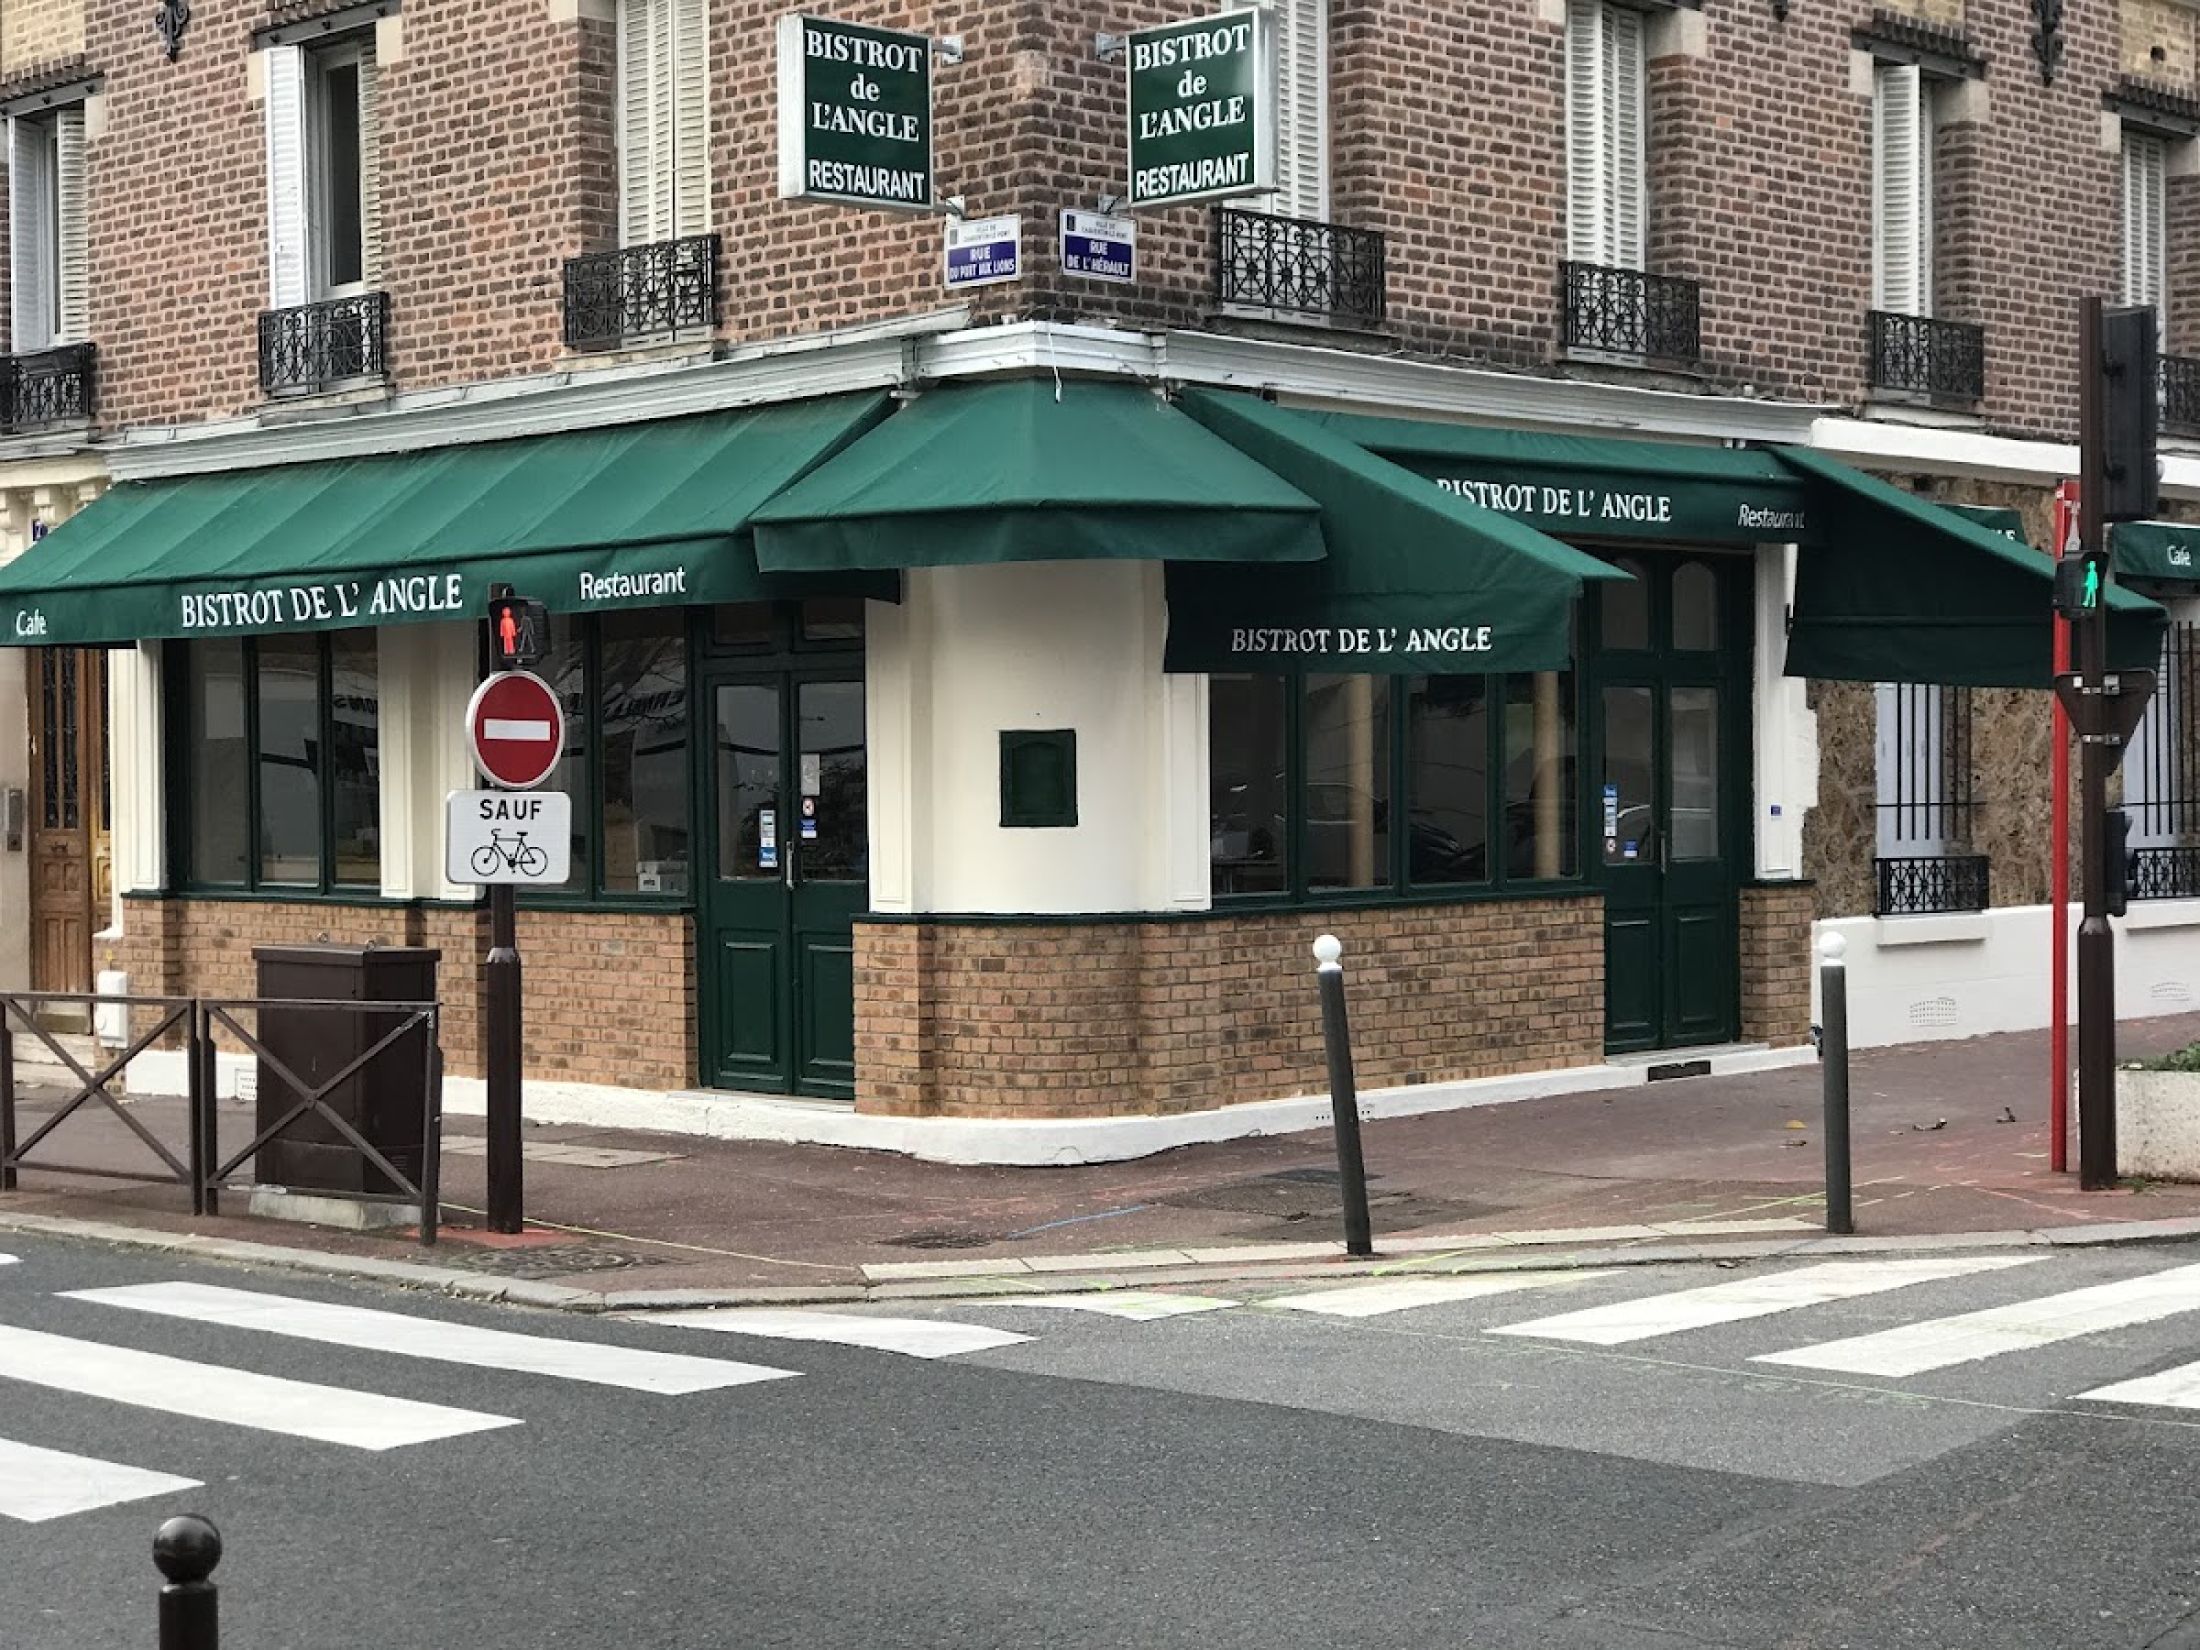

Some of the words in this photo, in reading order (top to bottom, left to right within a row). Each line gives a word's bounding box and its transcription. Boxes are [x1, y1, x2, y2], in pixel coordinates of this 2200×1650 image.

[805, 29, 922, 73] BISTROT
[1134, 23, 1250, 71] BISTROT
[850, 73, 880, 101] de
[1176, 69, 1207, 98] de
[811, 102, 919, 142] L'ANGLE
[1139, 95, 1246, 139] L'ANGLE
[809, 158, 925, 200] RESTAURANT
[1136, 152, 1249, 198] RESTAURANT
[970, 245, 991, 262] RUE
[1067, 254, 1080, 269] DE
[1089, 240, 1108, 256] RUE
[1543, 487, 1572, 516] DE
[1578, 489, 1595, 517] L'
[1601, 493, 1672, 522] ANGLE
[579, 566, 687, 600] Restaurant
[181, 589, 284, 628] BISTROT
[290, 586, 332, 621] DE
[335, 582, 359, 618] L'
[369, 573, 463, 615] ANGLE
[1231, 628, 1332, 653] BISTROT
[1338, 628, 1372, 653] DE
[1377, 628, 1397, 653] L'
[1404, 626, 1492, 653] ANGLE
[479, 799, 543, 821] SAUF
